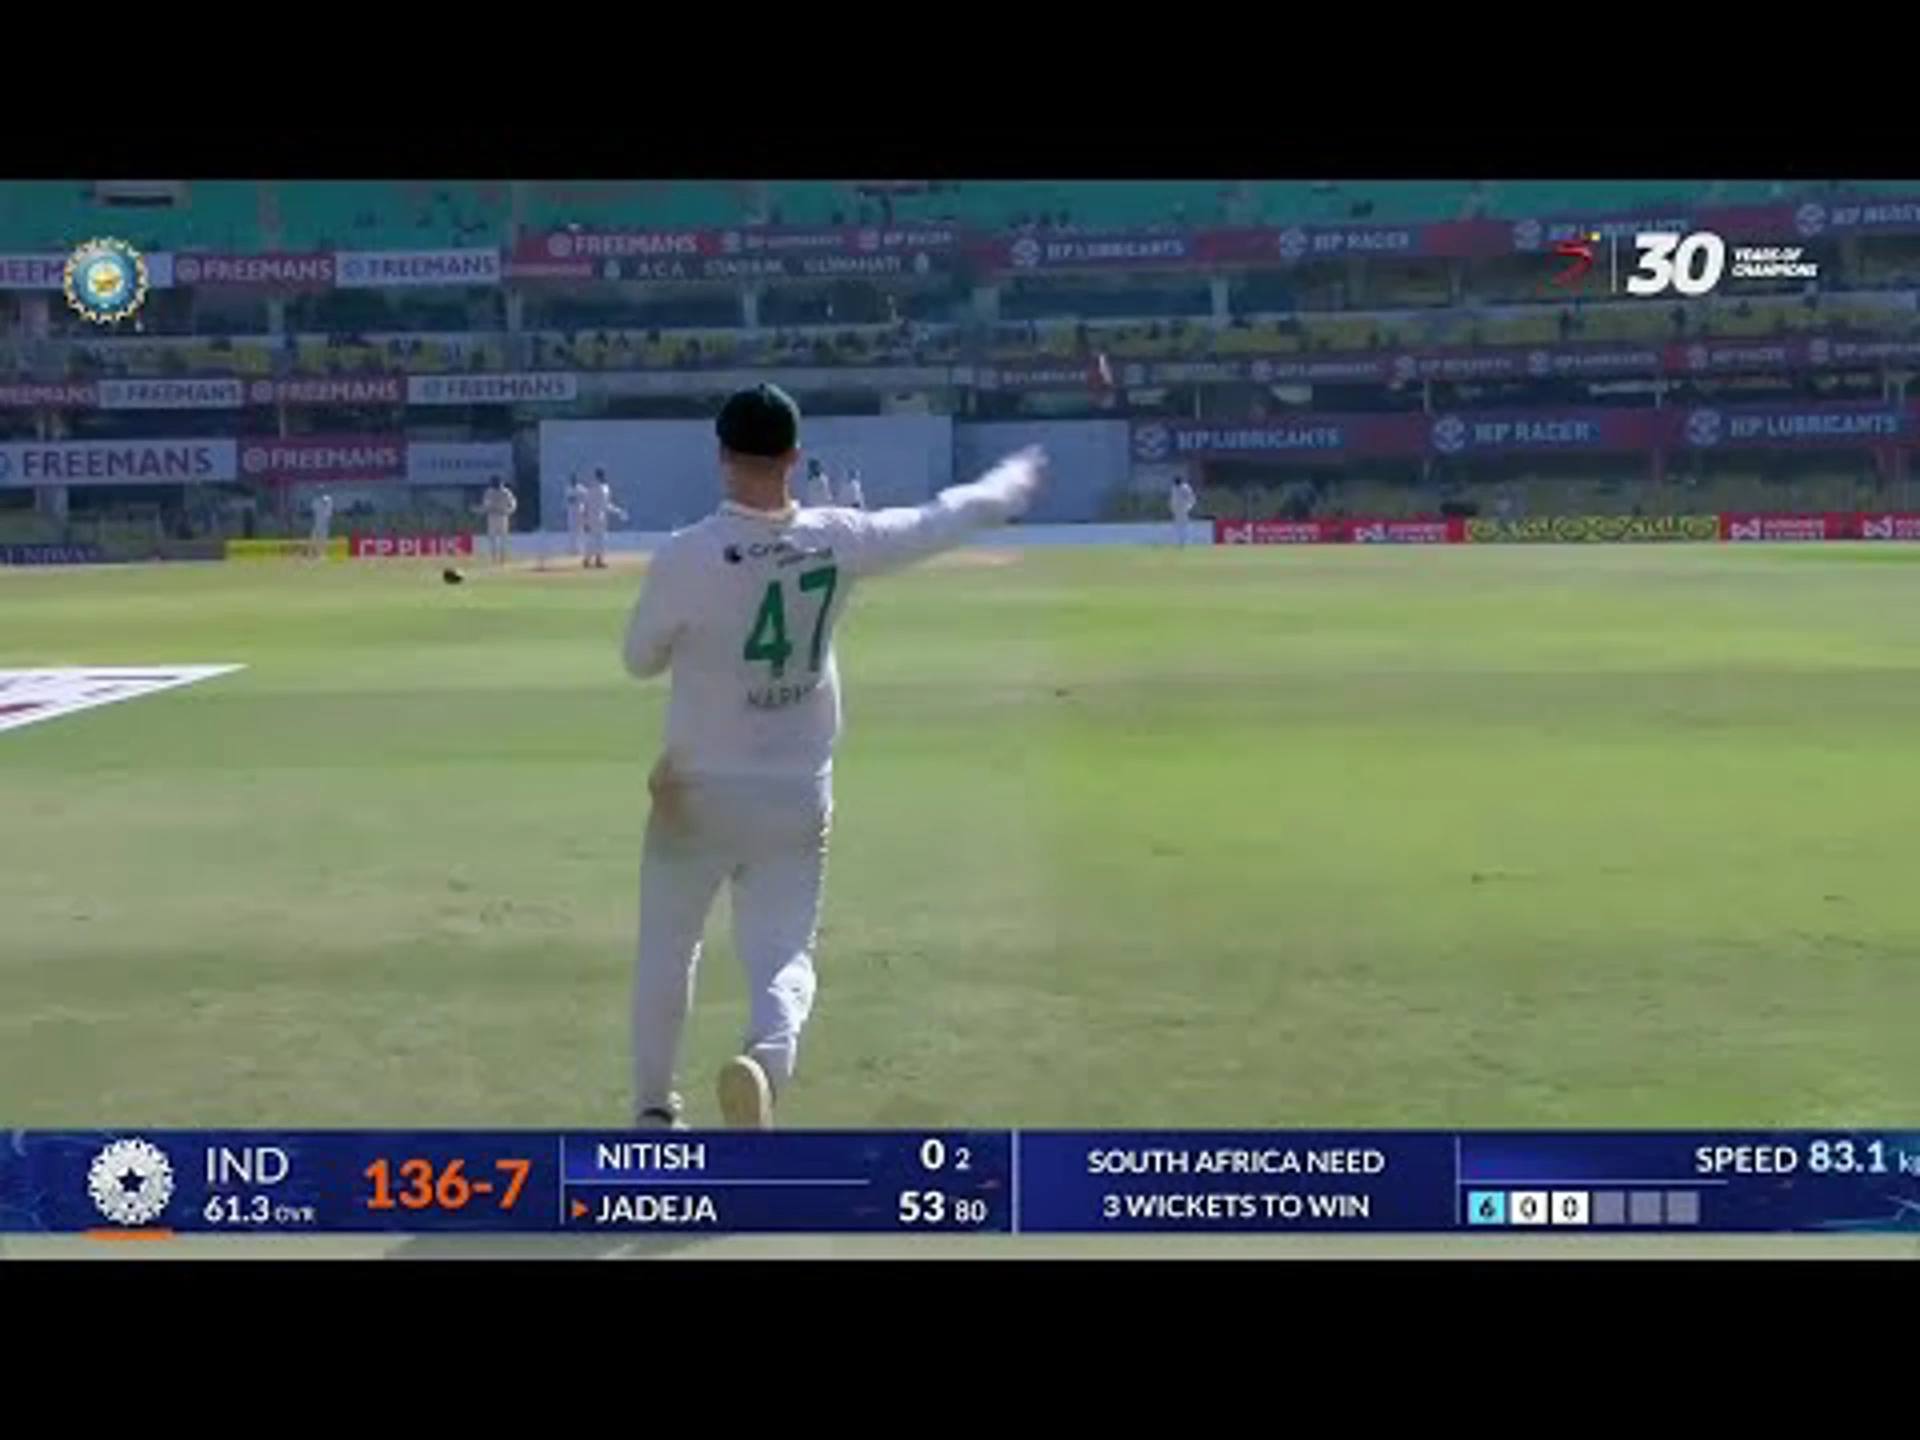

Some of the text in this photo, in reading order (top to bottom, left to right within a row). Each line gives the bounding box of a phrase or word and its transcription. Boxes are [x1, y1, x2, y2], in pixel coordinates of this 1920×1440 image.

[574, 232, 698, 254] FREEMANS
[203, 258, 333, 281] FREEMANS
[22, 447, 214, 478] FREEMANS
[271, 446, 398, 470] FREEMANS
[742, 565, 838, 679] 47
